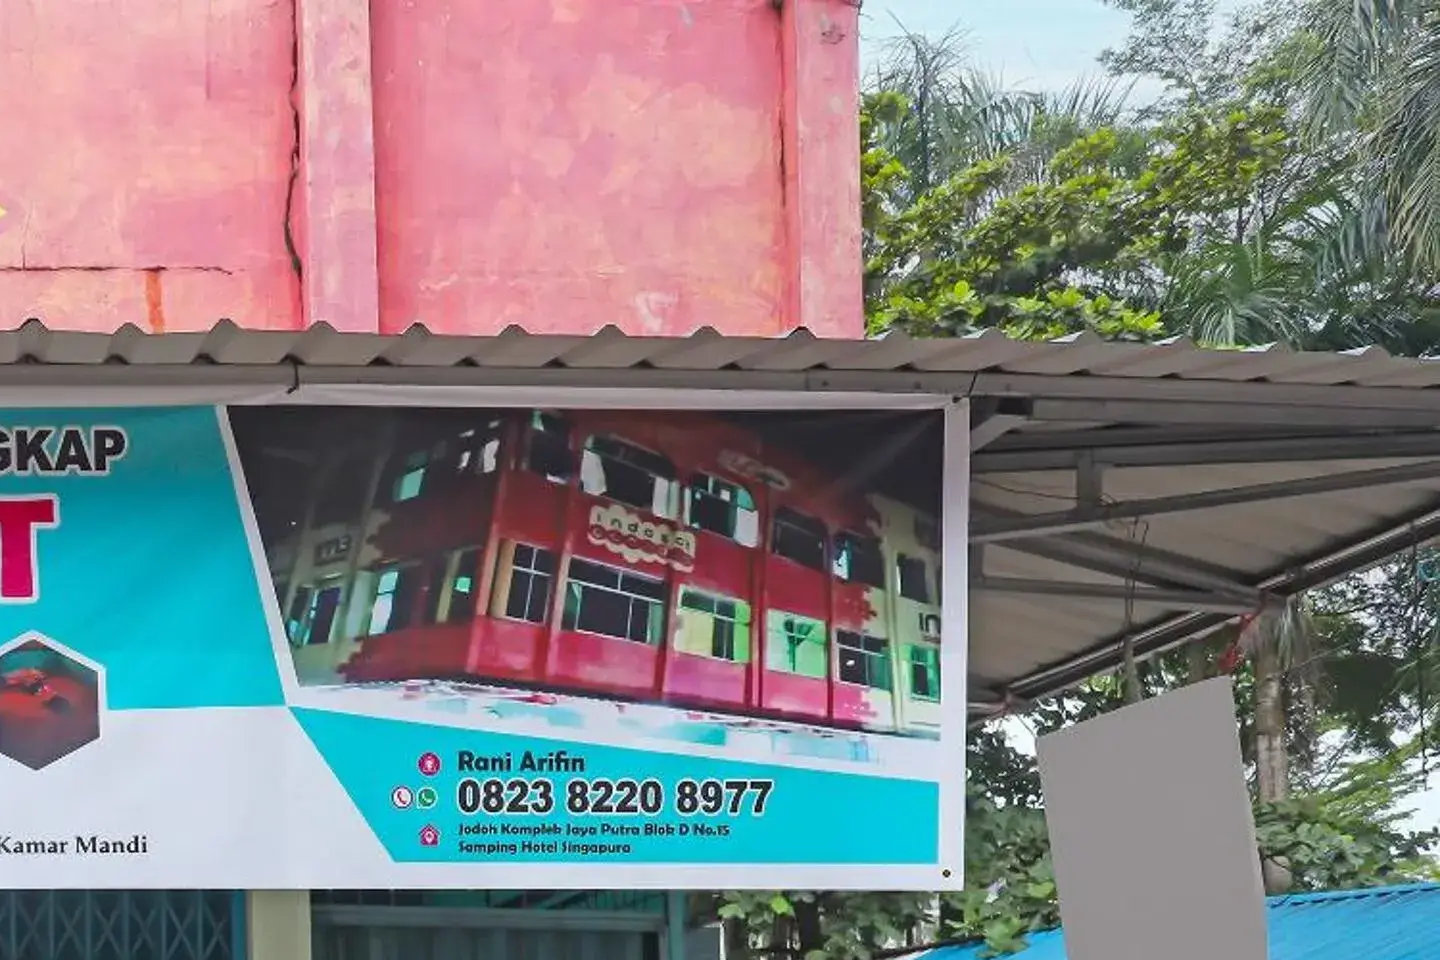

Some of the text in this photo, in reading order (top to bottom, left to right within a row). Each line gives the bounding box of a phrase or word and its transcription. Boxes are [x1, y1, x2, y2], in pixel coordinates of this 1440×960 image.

[459, 752, 584, 772] Rani Arifin
[459, 778, 773, 814] 0823 8220 8977
[566, 823, 596, 836] Jaya
[601, 824, 640, 835] Putra
[679, 824, 689, 835] D
[75, 835, 148, 854] Mandi
[522, 841, 558, 853] Hotel
[562, 841, 631, 854] Singapura
